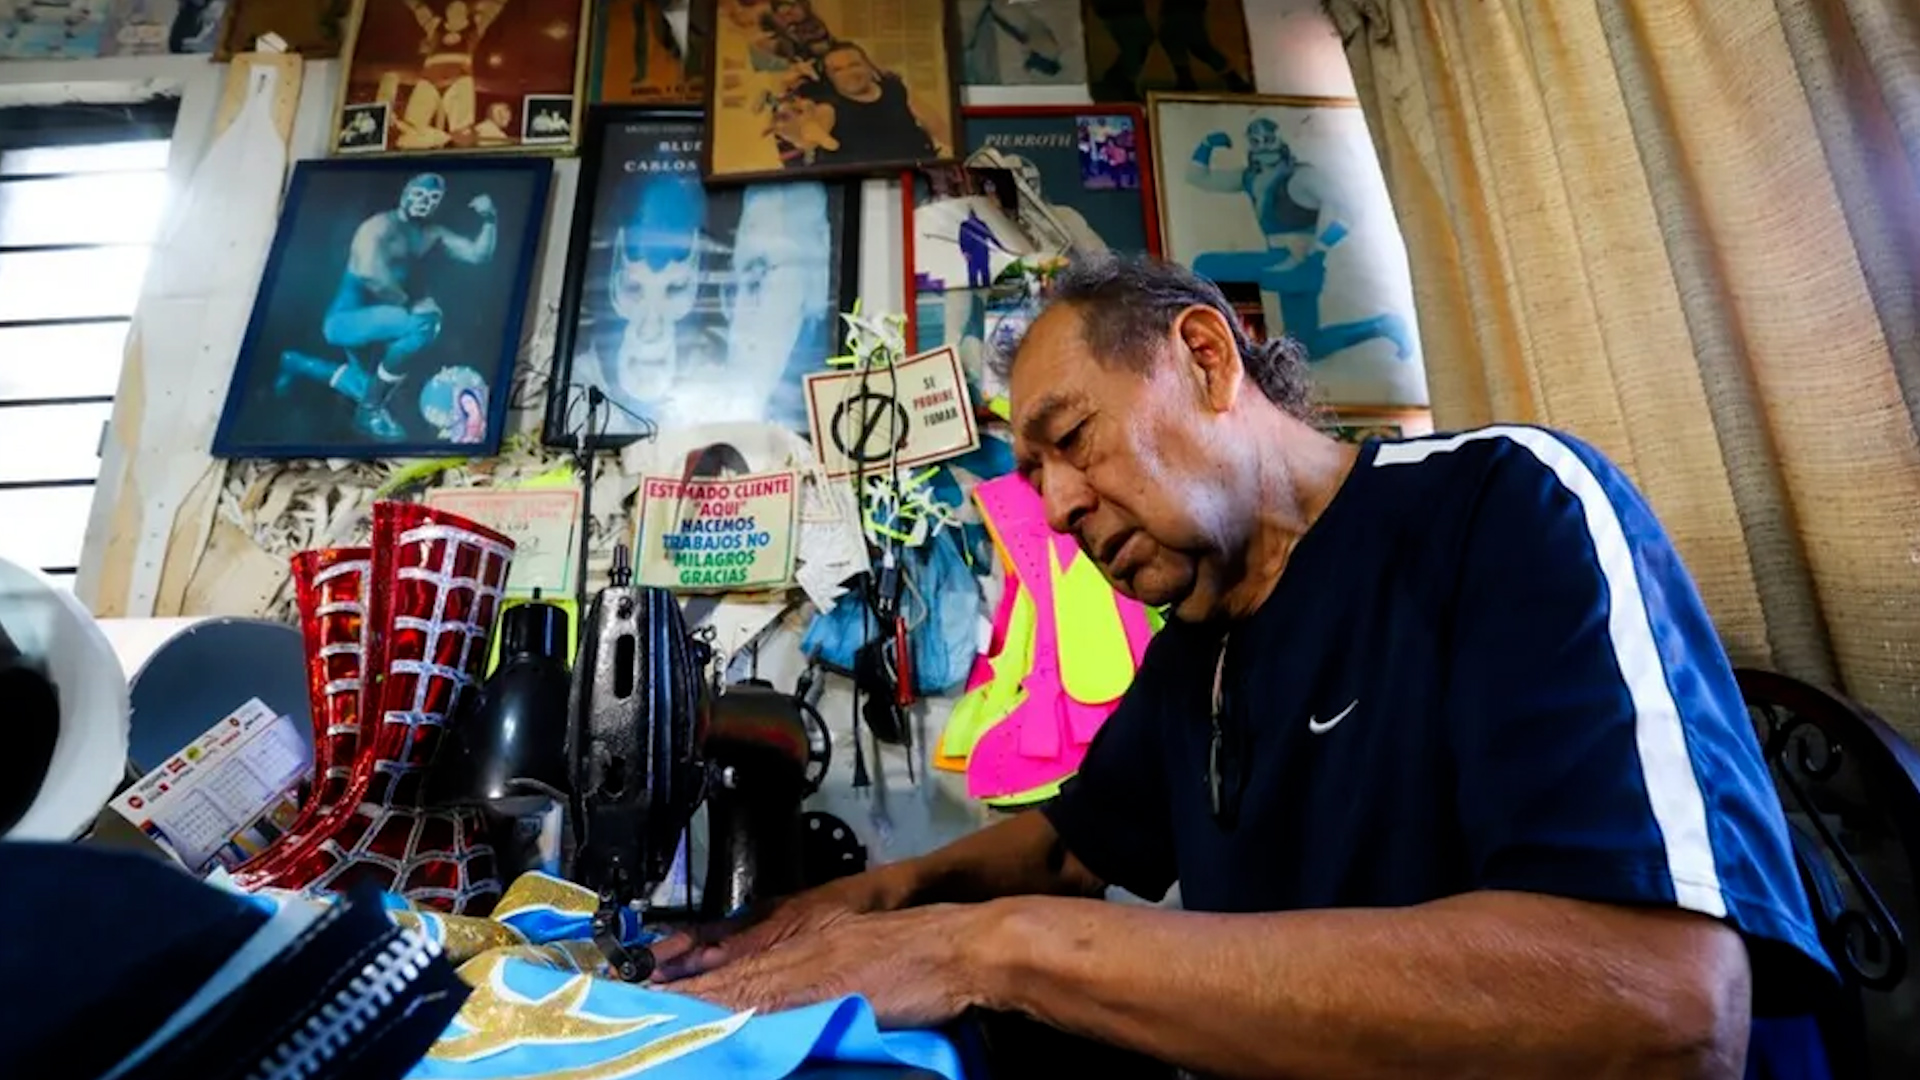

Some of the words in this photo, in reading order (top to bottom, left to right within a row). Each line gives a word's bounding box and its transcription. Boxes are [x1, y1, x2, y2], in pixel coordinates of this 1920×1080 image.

[984, 133, 1072, 147] PIERROTH
[624, 160, 697, 173] CARLOS
[923, 376, 936, 390] SE
[923, 406, 958, 427] FUMAR
[650, 483, 730, 499] ESTIMADO
[734, 479, 789, 498] CLIENTE
[681, 516, 755, 533] HACEMOS
[662, 534, 742, 551] TRABAJOS
[747, 532, 770, 547] NO
[674, 550, 756, 567] MILAGROS
[680, 568, 748, 584] GRACIAS
